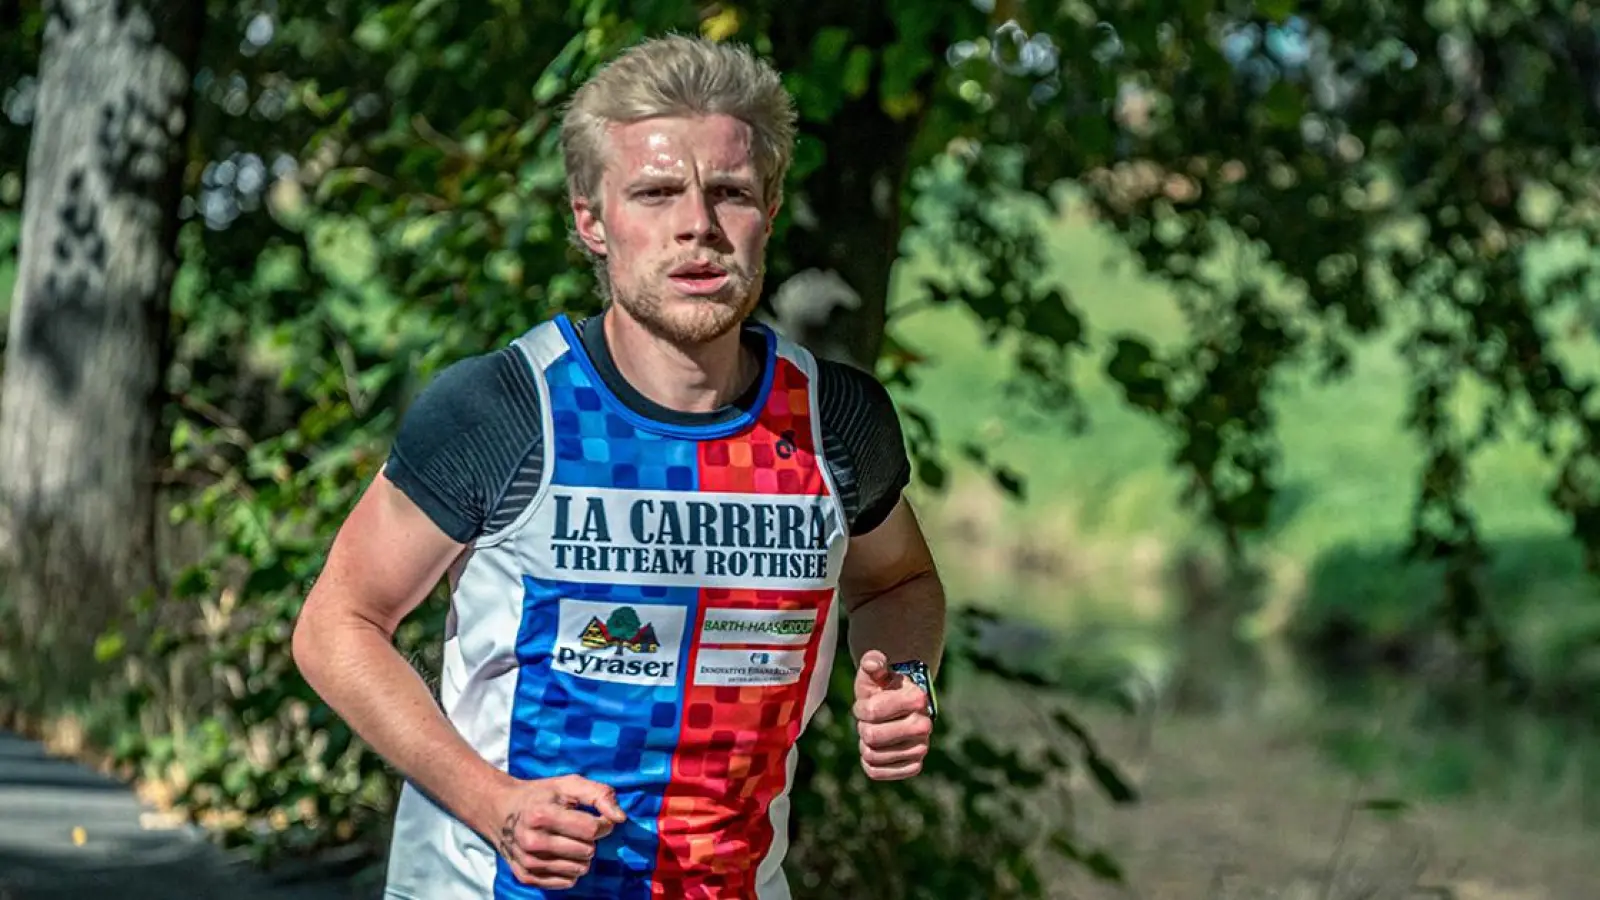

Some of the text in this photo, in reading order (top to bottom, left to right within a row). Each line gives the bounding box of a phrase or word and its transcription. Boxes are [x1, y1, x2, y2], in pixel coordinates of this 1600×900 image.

[551, 495, 829, 550] LA CARRERA
[550, 543, 828, 579] TRITEAM ROTHSEE
[557, 646, 674, 678] Pyraser
